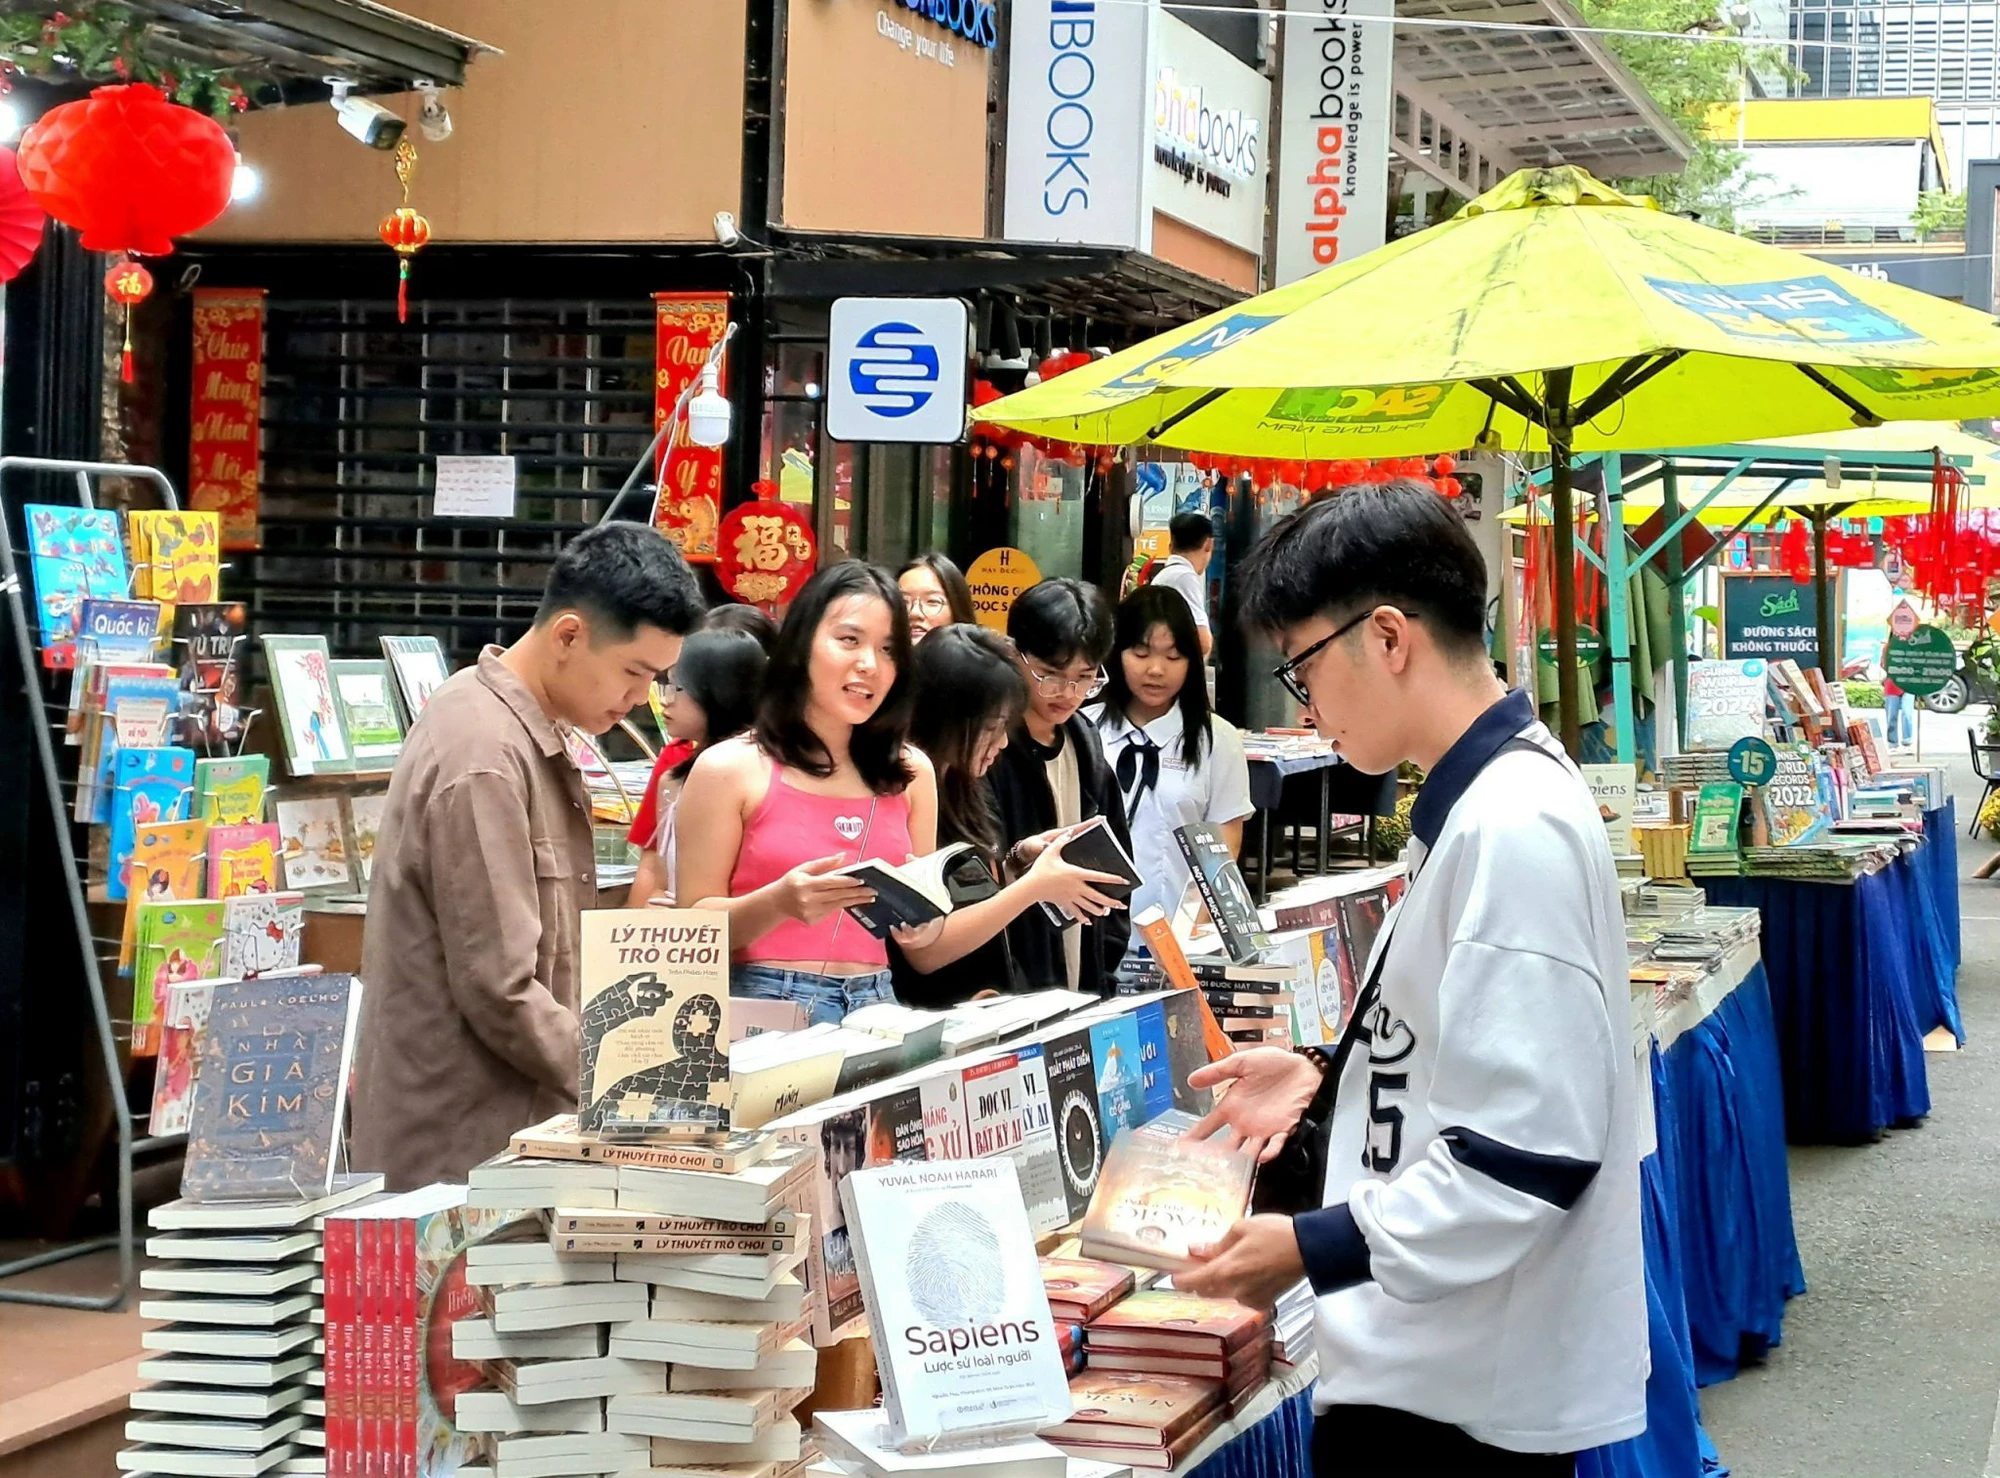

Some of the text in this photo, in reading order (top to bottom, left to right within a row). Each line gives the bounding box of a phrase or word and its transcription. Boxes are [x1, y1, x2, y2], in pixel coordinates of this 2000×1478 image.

[877, 10, 955, 67] Change your life
[1342, 22, 1364, 197] knowledge is power
[207, 331, 250, 360] Chúc
[204, 371, 252, 401] Mừng
[205, 411, 249, 441] Năm
[208, 451, 243, 481] Mới
[732, 515, 789, 572] 福
[1000, 549, 1010, 567] H
[969, 582, 1010, 597] HÔNG
[95, 612, 152, 637] Quốc kì
[1743, 624, 1817, 638] ĐƯỜNG SÁCH
[1732, 639, 1813, 653] KHÔNG THUỐC
[1776, 761, 1807, 774] ORLD
[1770, 785, 1816, 807] 2022
[610, 923, 721, 944] LÝ THUYẾT
[618, 944, 720, 964] TRÒ CHƠI
[238, 1031, 307, 1053] NHÀ
[230, 1055, 305, 1084] GIẢ
[979, 1087, 1012, 1120] ĐỌC VỊ
[1037, 1102, 1049, 1127] AI
[924, 1106, 948, 1129] NĂNG
[896, 1137, 911, 1152] SAO
[975, 1125, 993, 1155] BẤT
[1011, 1118, 1023, 1143] AI
[603, 1148, 706, 1168] LÝ THUYẾT TRÒ CHƠI
[879, 1175, 917, 1188] YUVAL
[920, 1171, 953, 1184] NOAH
[956, 1168, 998, 1181] HARARI
[659, 1219, 674, 1231] LÝ
[674, 1219, 715, 1232] THUYẾT
[656, 1236, 765, 1251] LÝ THUYẾT TRÒ CHƠI
[905, 1317, 1040, 1357] Sapiens
[924, 1349, 1032, 1374] Lược sử loài người
